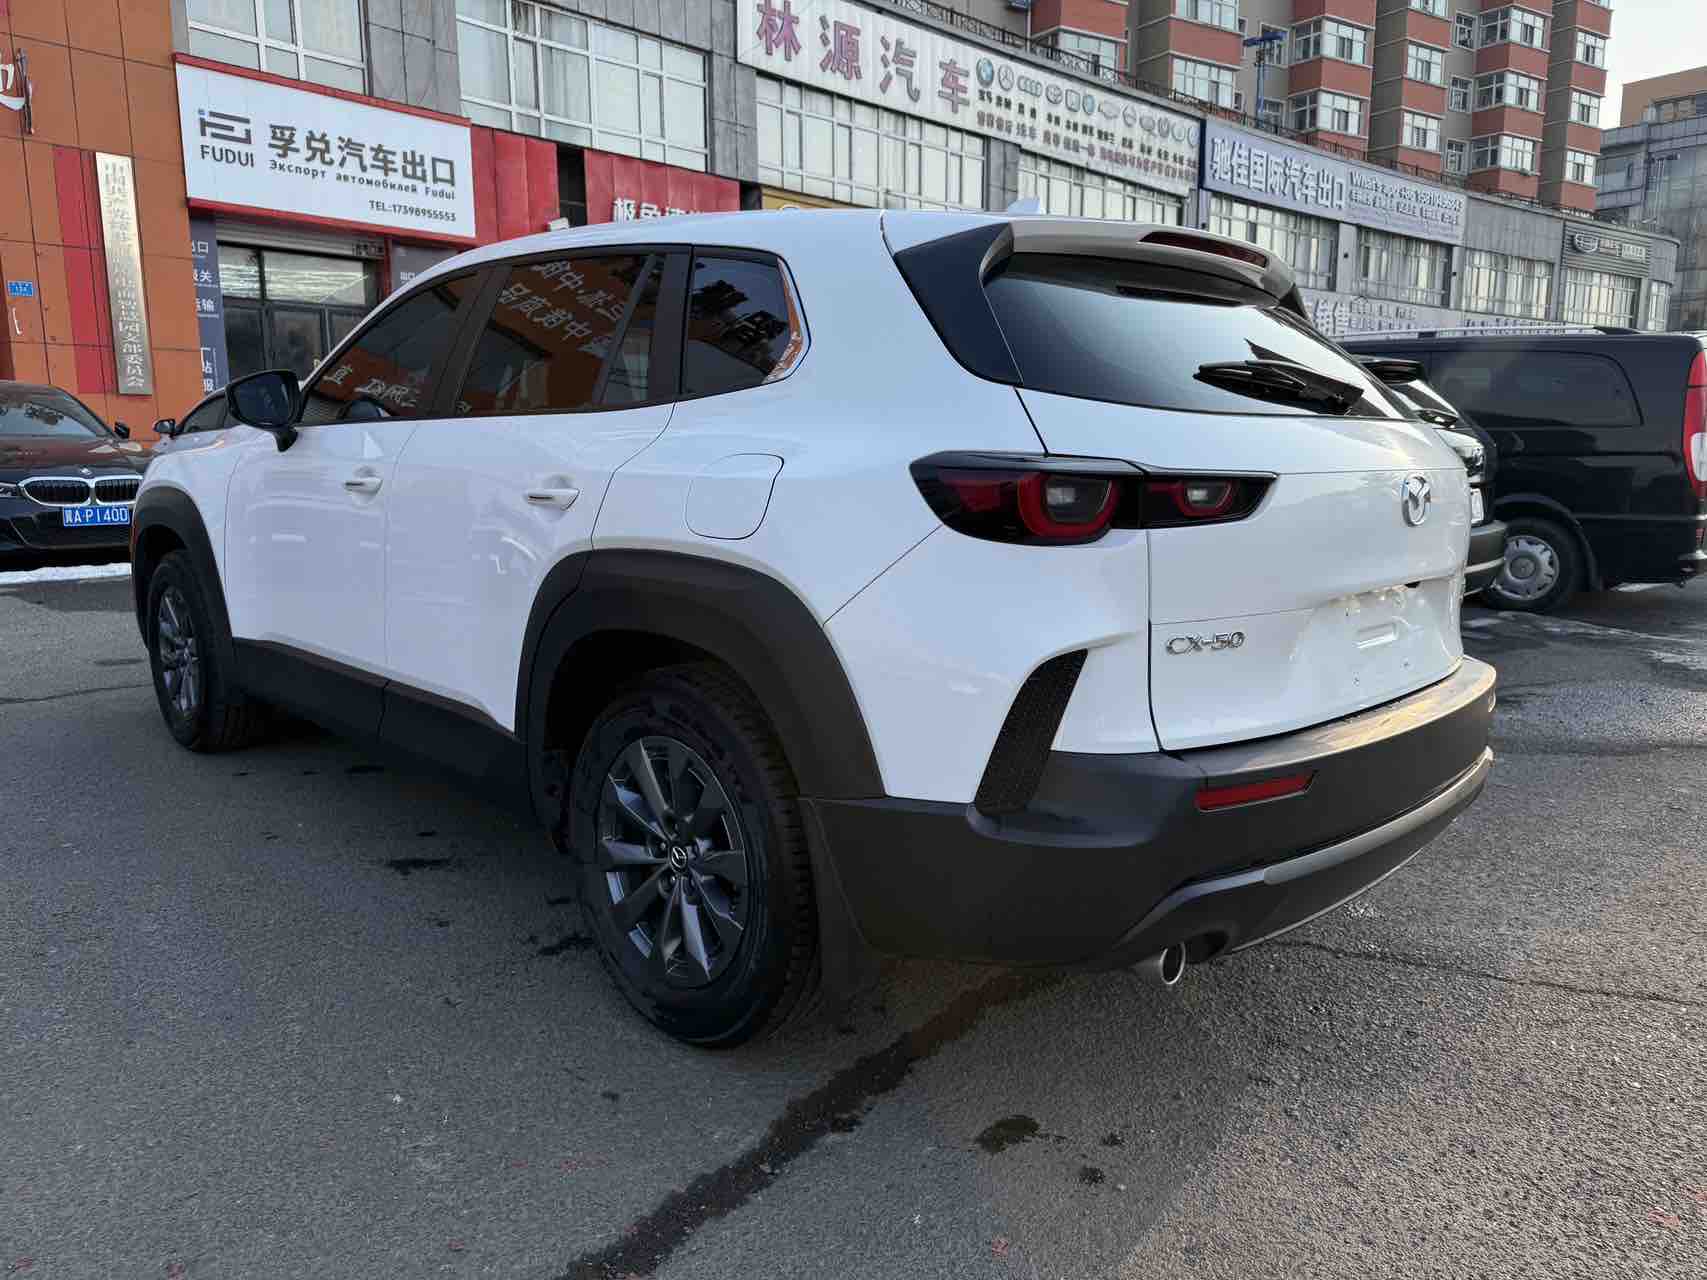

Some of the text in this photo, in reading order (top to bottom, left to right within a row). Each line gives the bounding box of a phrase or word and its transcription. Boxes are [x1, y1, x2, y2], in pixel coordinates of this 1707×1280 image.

[756, 0, 971, 114] 林源汽车
[200, 145, 254, 168] FUDUI
[267, 124, 456, 187] 孚兑汽车出口
[269, 160, 455, 200] Экспорт автомобилей Fudui
[1166, 631, 1245, 655] CX-50
